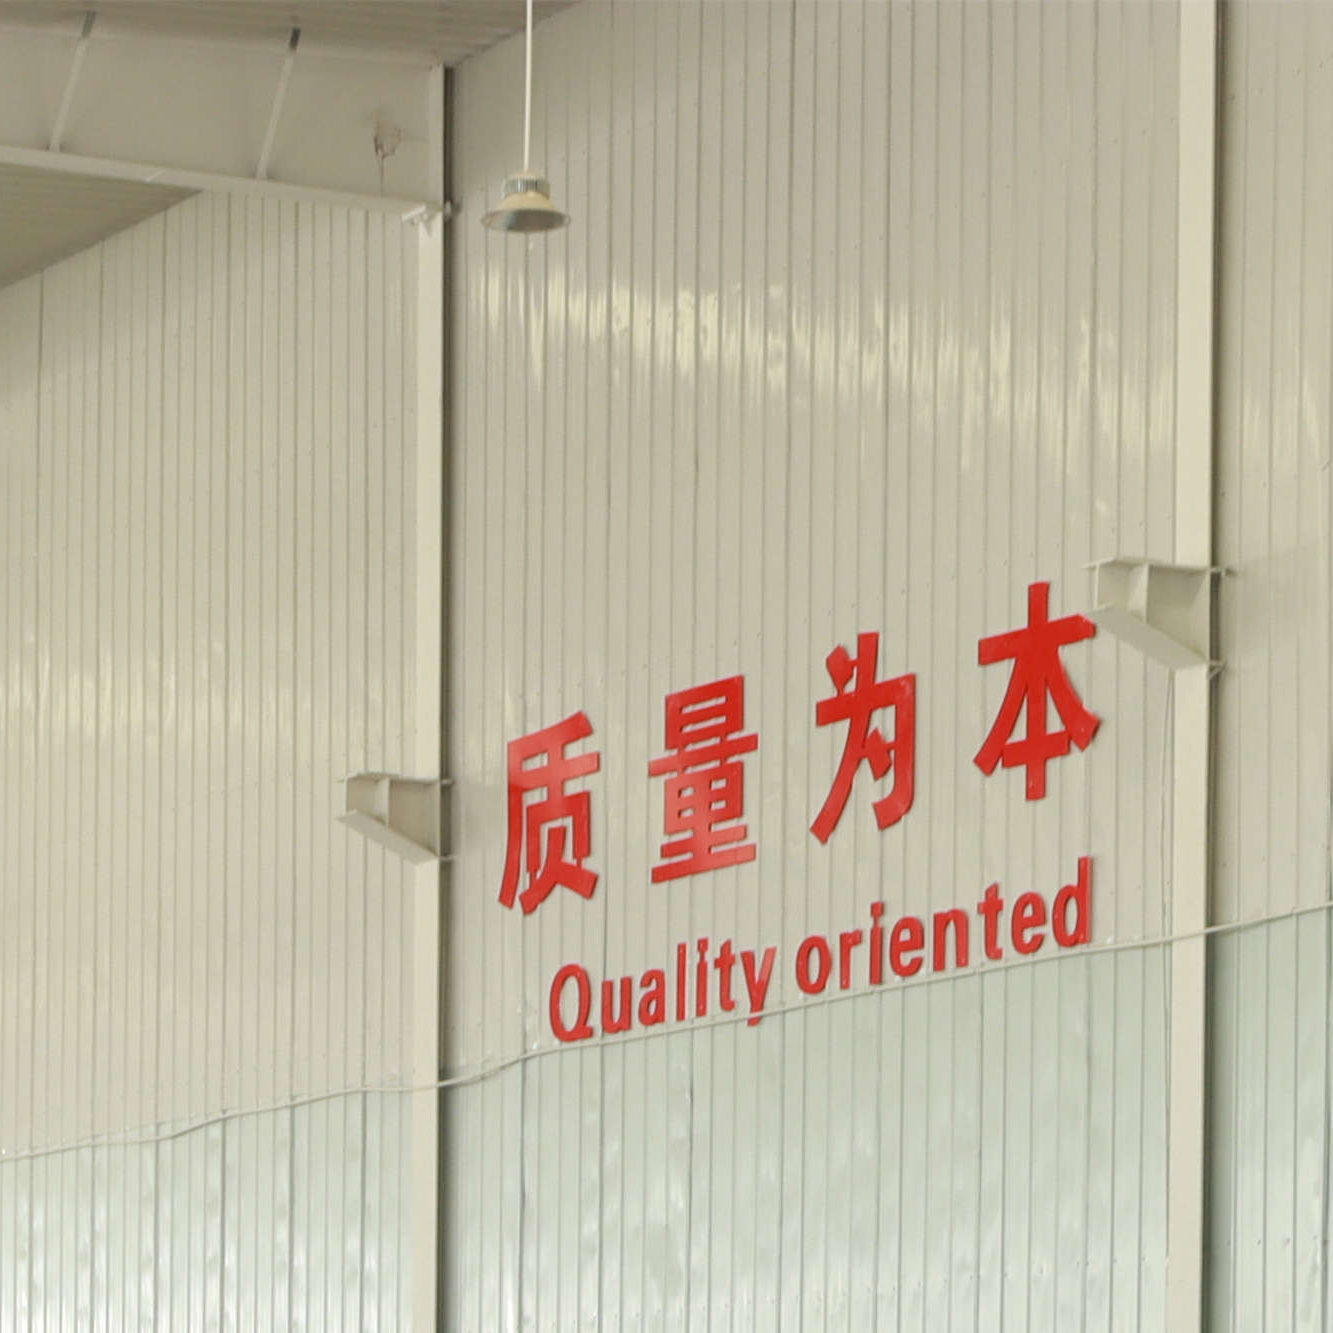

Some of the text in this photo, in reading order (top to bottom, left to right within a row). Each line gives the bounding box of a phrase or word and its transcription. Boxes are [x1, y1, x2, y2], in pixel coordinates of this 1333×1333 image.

[498, 582, 1103, 916] 质量为本
[548, 854, 1094, 1044] Quality oriented
